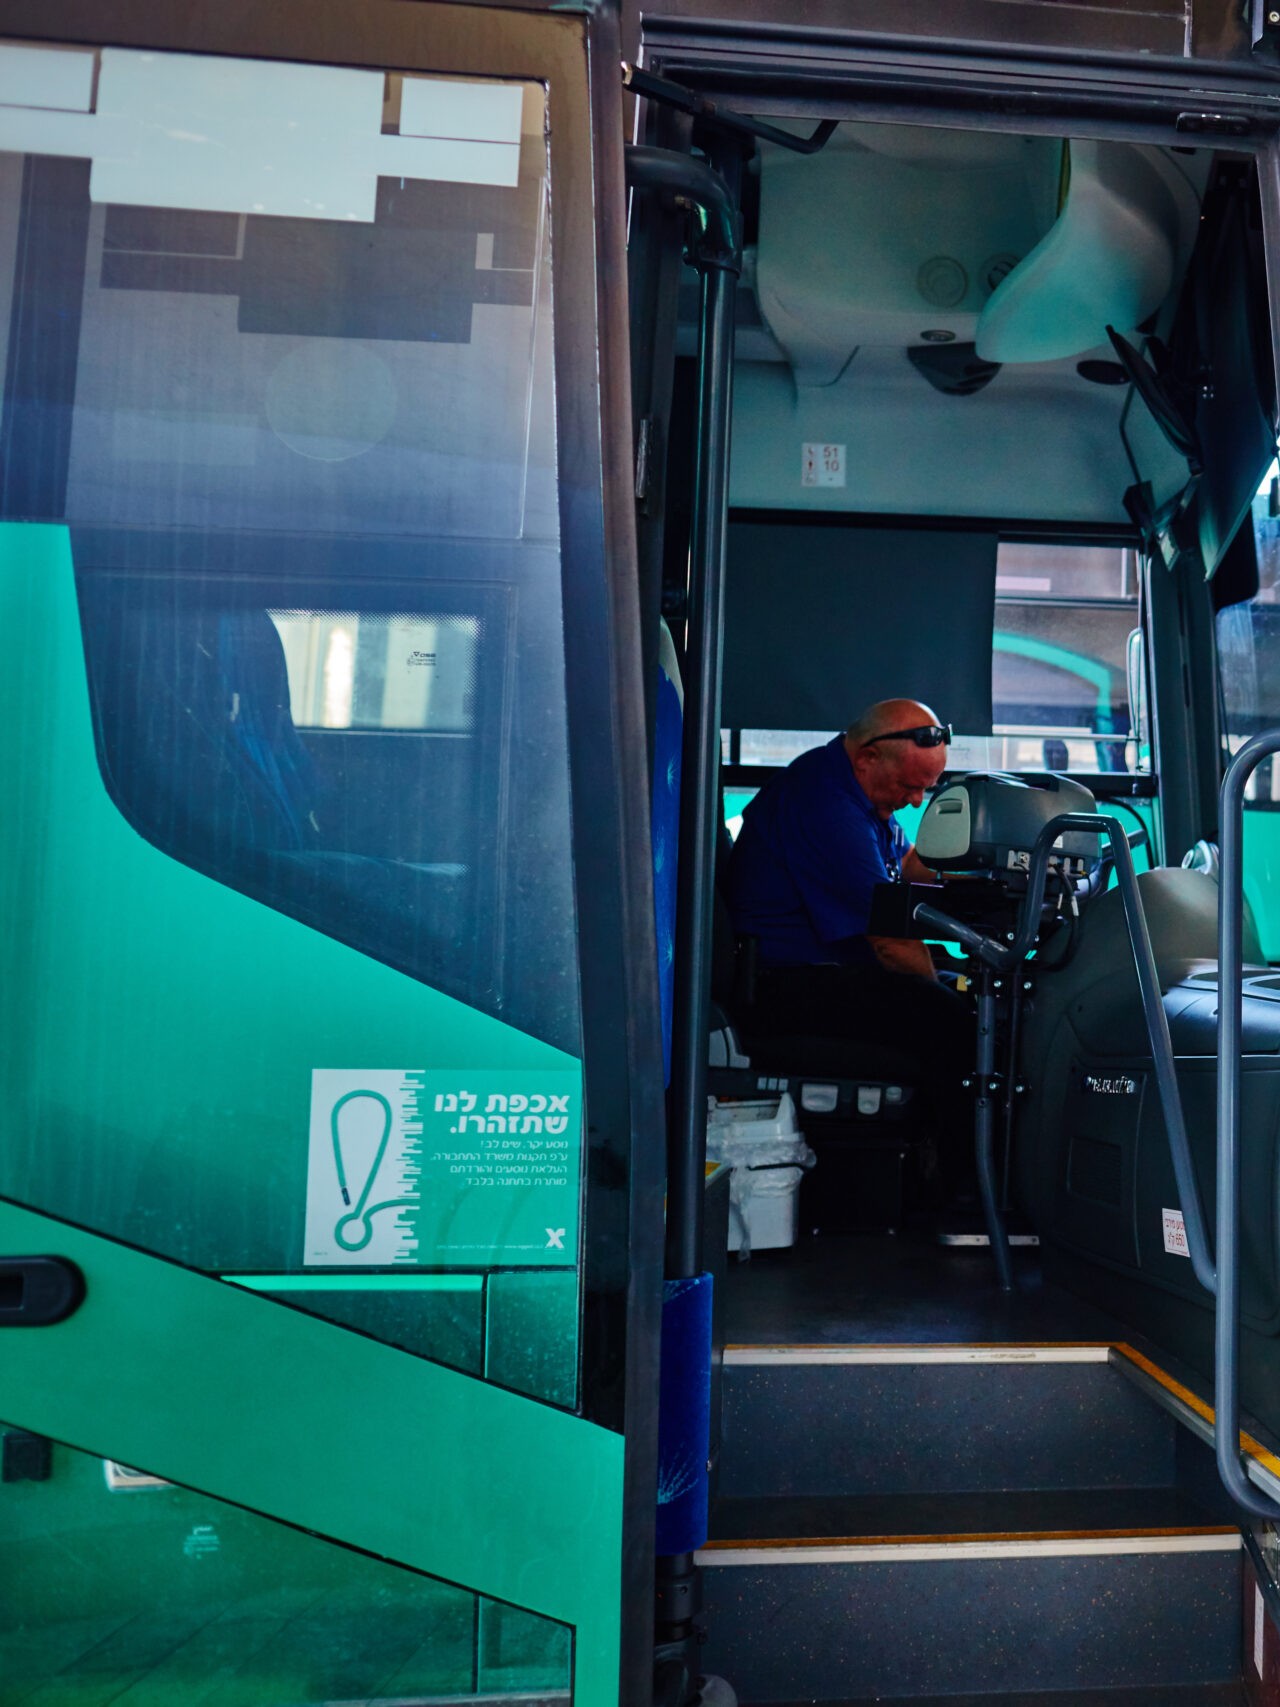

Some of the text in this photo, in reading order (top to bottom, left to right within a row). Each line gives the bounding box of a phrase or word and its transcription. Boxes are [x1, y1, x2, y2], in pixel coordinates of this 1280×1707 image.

[434, 1090, 570, 1113] אכפת לנו
[450, 1115, 569, 1134] שתזהרו.
[546, 1140, 568, 1149] נוסע
[484, 1153, 514, 1161] משרד
[517, 1153, 546, 1162] תקנות
[495, 1165, 528, 1173] נוסעים
[531, 1164, 567, 1173] העלאת
[534, 1177, 567, 1186] מותרת
